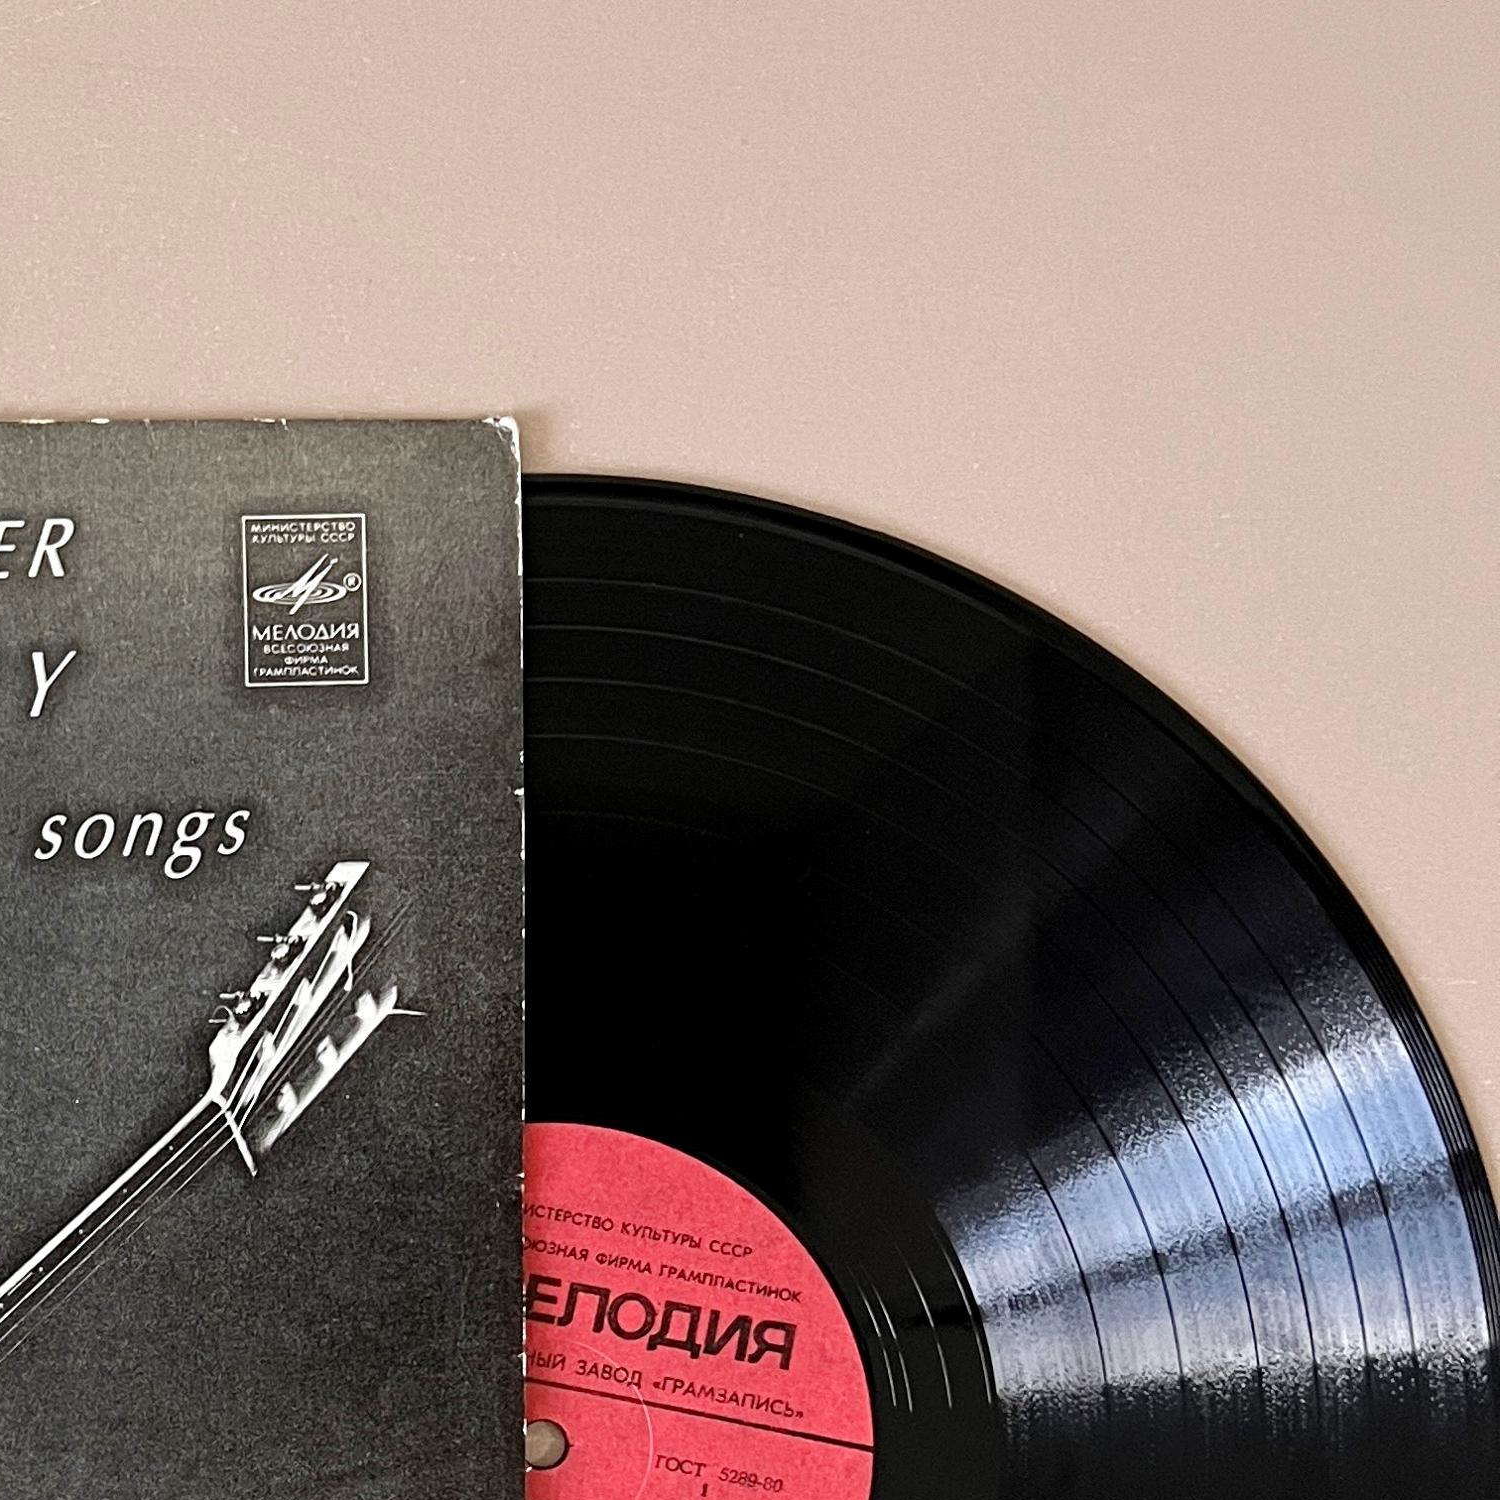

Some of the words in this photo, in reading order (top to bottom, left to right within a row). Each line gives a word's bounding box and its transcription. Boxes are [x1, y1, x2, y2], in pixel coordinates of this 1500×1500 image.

[250, 521, 356, 533] МИНИСТЕРСТВО
[252, 534, 316, 545] КУЛЬТУРЫ
[320, 532, 355, 543] СССР
[252, 622, 360, 641] МЕЛОДИЯ
[263, 642, 350, 655] ВСЕСОЮЗНАЯ
[284, 655, 329, 666] ФИРМА
[253, 665, 359, 677] ГРАМПЛАСТИНОК
[34, 809, 251, 879] songs
[620, 1221, 701, 1249] КУЛЬТУРЫ
[708, 1239, 754, 1259] СССР
[595, 1252, 653, 1275] ФИРМА
[658, 1264, 804, 1304] ГРАМПЛАСТИНОК
[575, 1359, 643, 1390] ЗАВОД
[655, 1454, 707, 1478] ГОСТ
[718, 1467, 784, 1493] 5289-80
